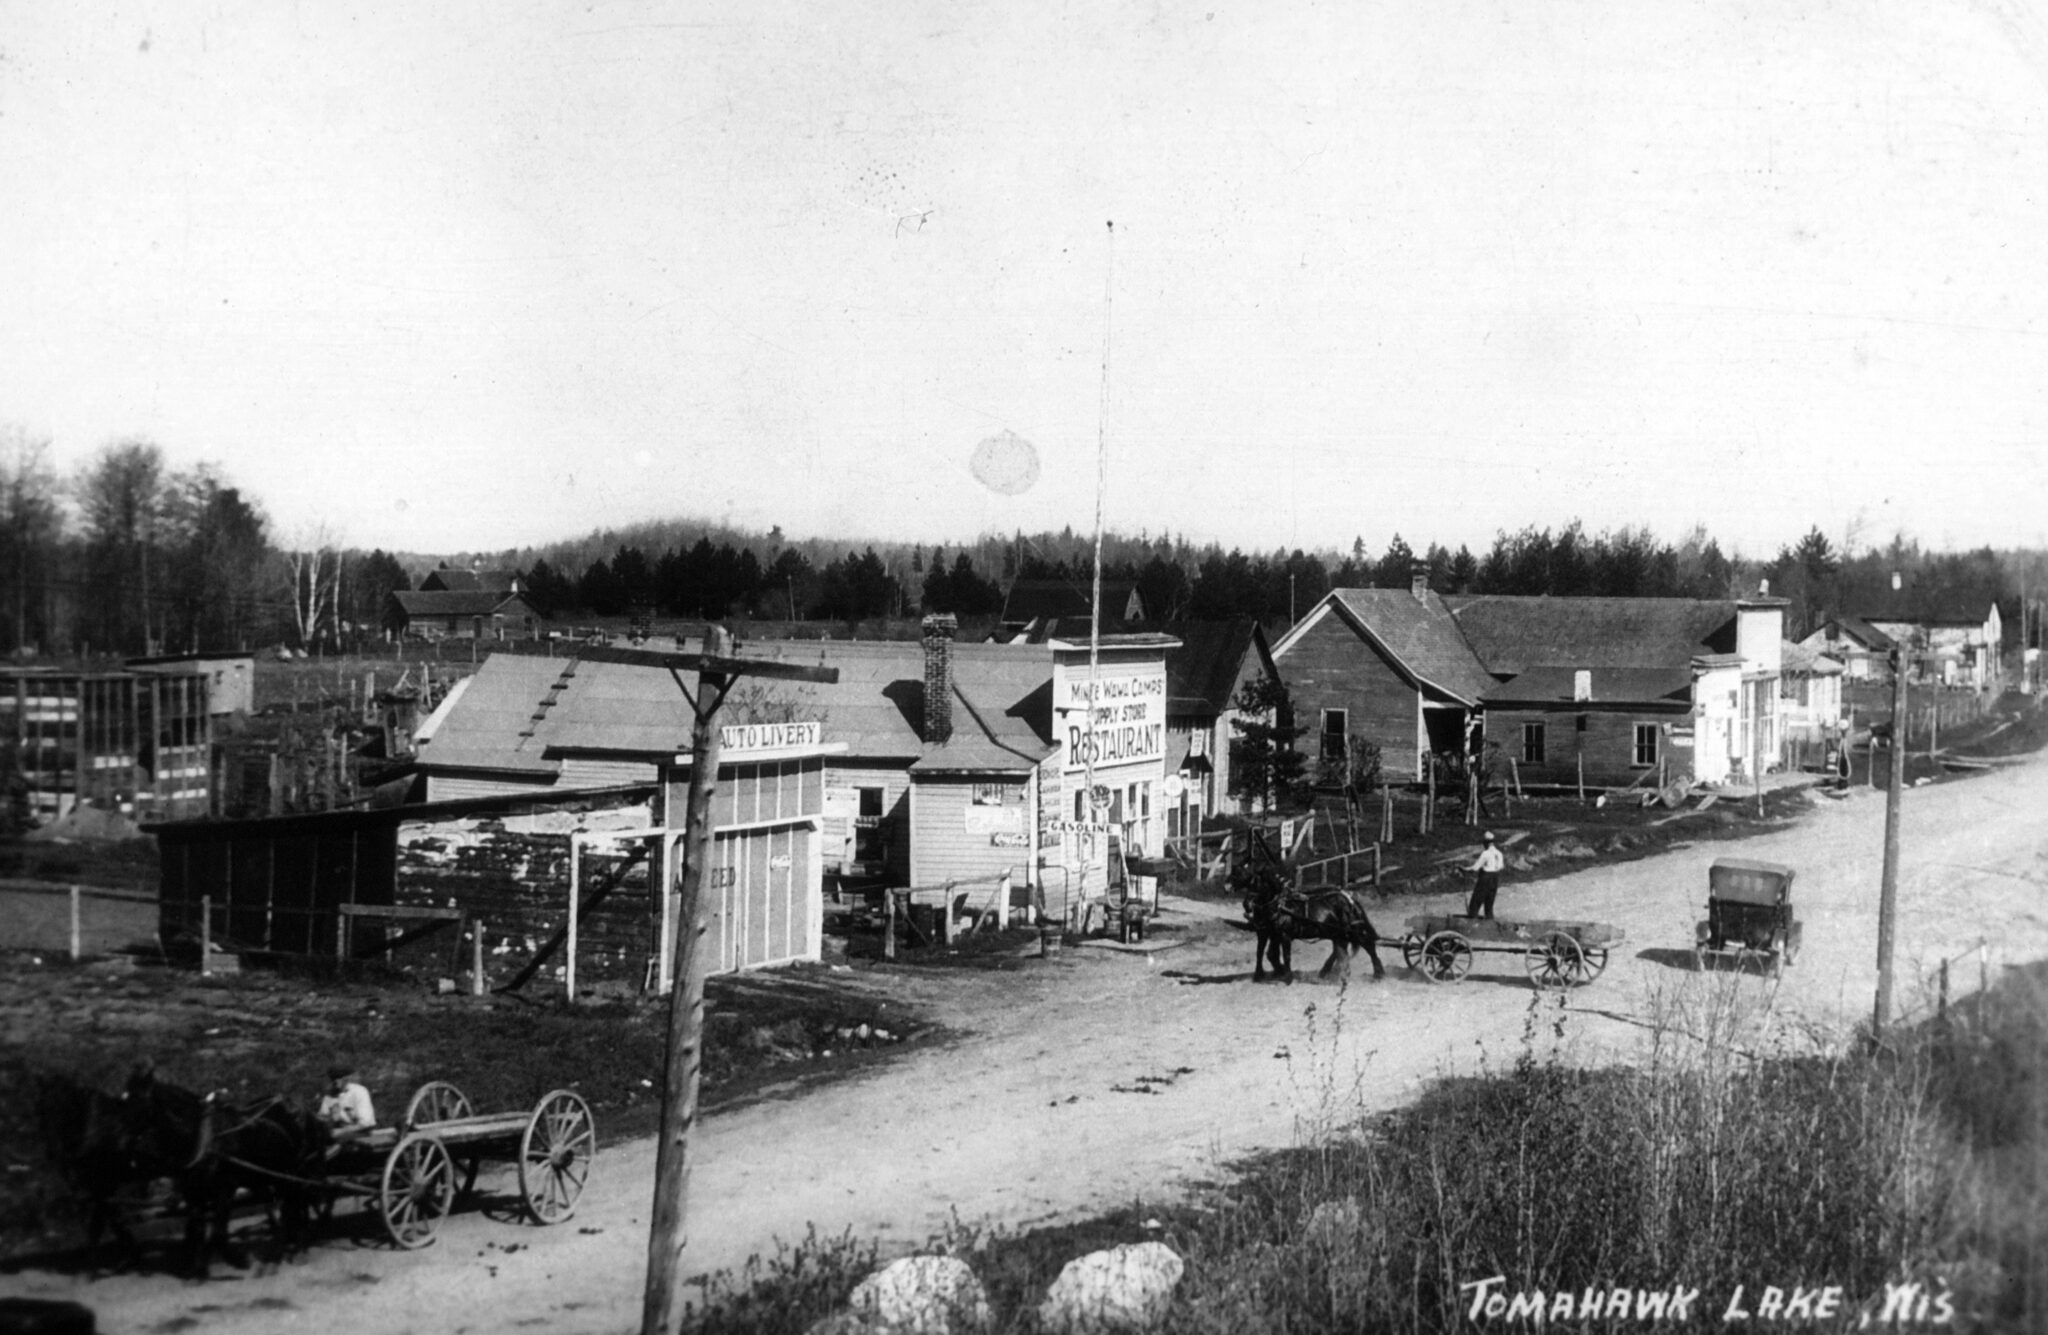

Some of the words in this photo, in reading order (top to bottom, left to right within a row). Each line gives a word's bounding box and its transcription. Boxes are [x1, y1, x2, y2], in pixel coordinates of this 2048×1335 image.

[761, 724, 816, 746] LIVERY
[1069, 723, 1161, 765] RESTAURANT
[1051, 822, 1113, 834] GASOLINE
[711, 867, 736, 888] EED
